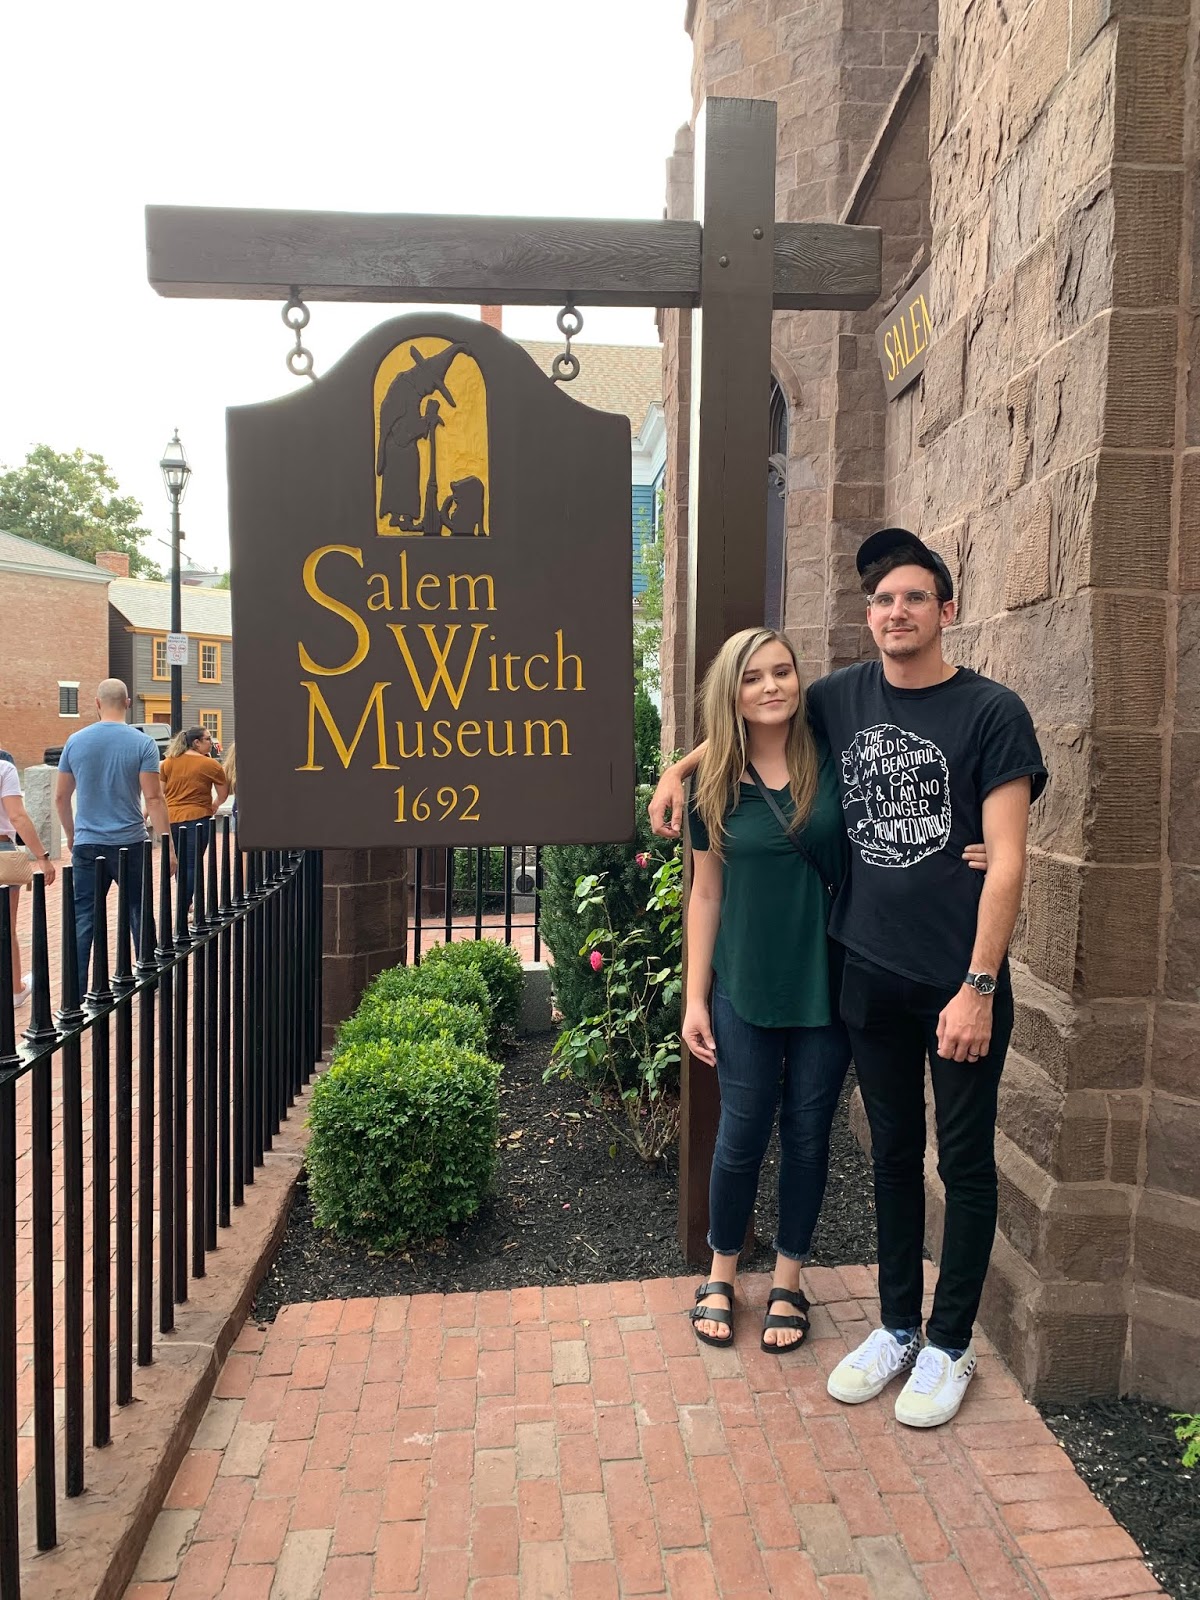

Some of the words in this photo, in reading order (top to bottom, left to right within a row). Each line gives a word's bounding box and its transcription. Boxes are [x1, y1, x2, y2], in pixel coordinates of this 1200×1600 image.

[298, 544, 498, 676] Salem
[386, 623, 586, 711] Witch
[295, 681, 572, 771] Museum
[864, 730, 884, 745] THE
[858, 740, 894, 762] WORLD
[896, 738, 908, 752] IS
[870, 761, 879, 777] A
[881, 749, 938, 775] BEAUTIFUL
[889, 766, 920, 786] CAT
[394, 784, 480, 822] 1692
[890, 786, 895, 800] I
[900, 784, 917, 801] AM
[920, 779, 940, 797] NO
[876, 799, 931, 818] LONGER
